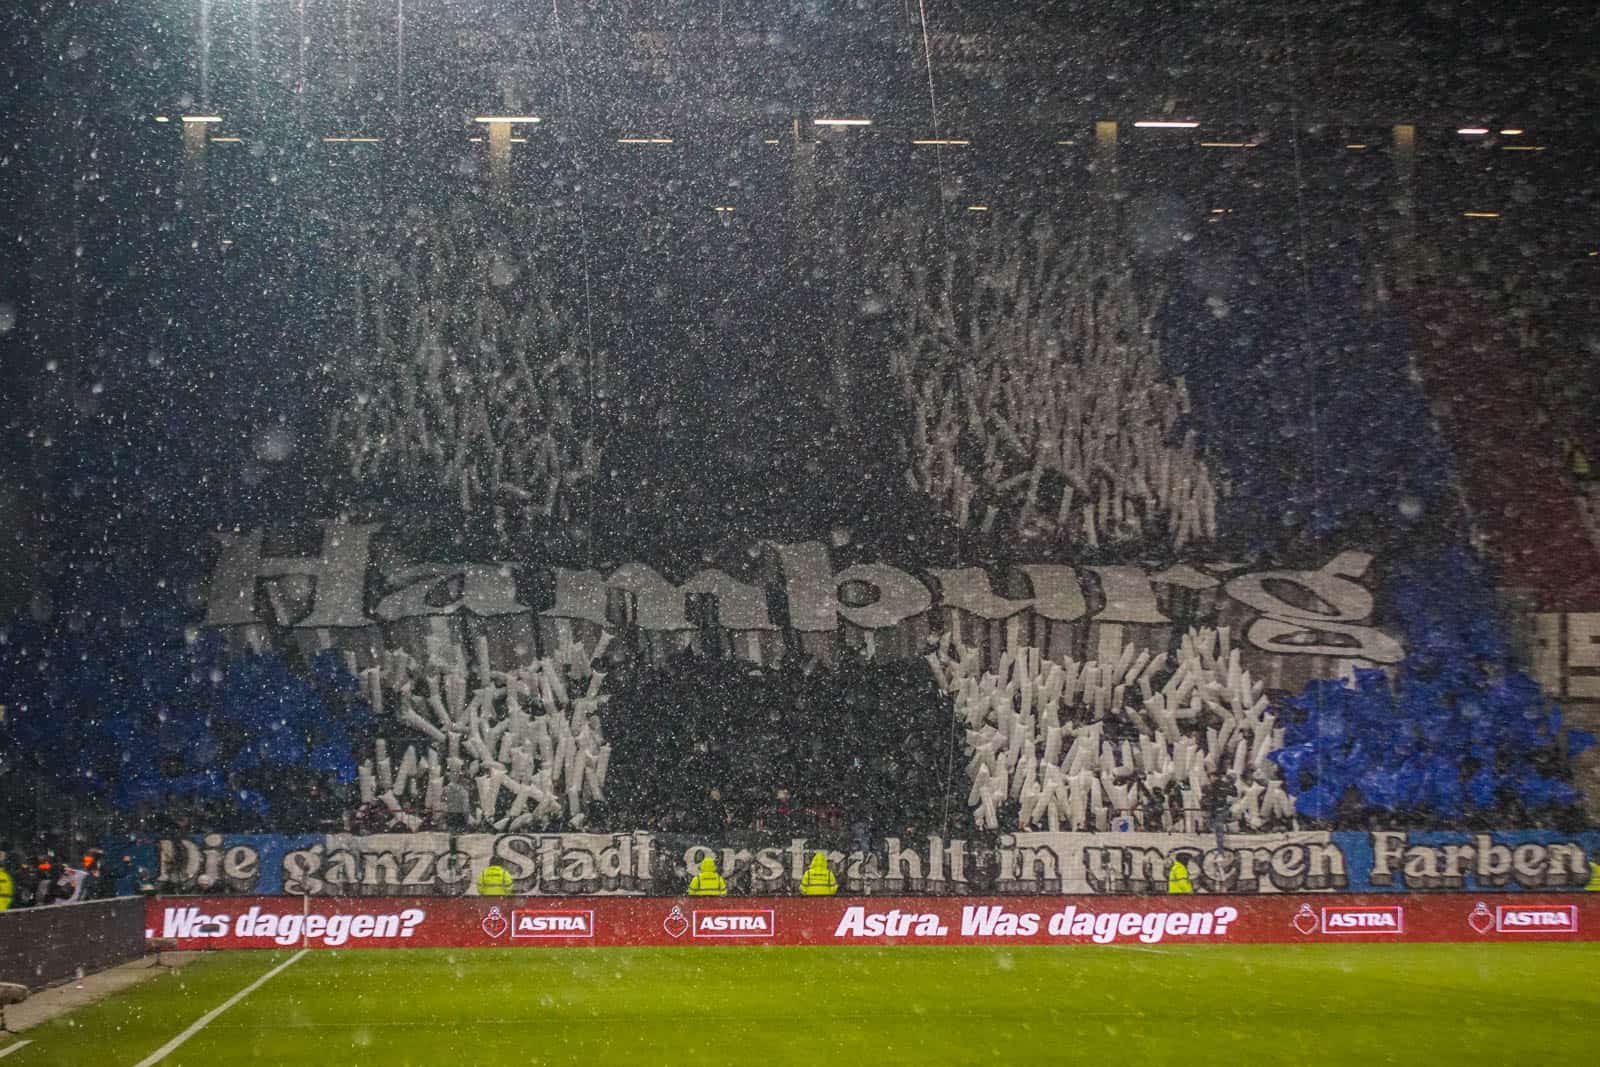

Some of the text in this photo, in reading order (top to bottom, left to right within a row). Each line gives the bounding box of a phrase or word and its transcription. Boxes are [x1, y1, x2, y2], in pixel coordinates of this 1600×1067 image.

[205, 517, 1406, 664] Hamburg
[158, 833, 258, 884] Die
[284, 844, 470, 895] ganze
[494, 833, 656, 882] Stadt
[997, 834, 1059, 881] in
[1373, 832, 1588, 878] Farben
[163, 906, 425, 945] Was dagegen?
[519, 916, 586, 931] ASTRA
[699, 916, 767, 931] ASTRA
[834, 905, 1238, 944] Astra. Was dagegen?
[1328, 913, 1394, 928] ASTRA
[1503, 911, 1570, 927] ASTRA
